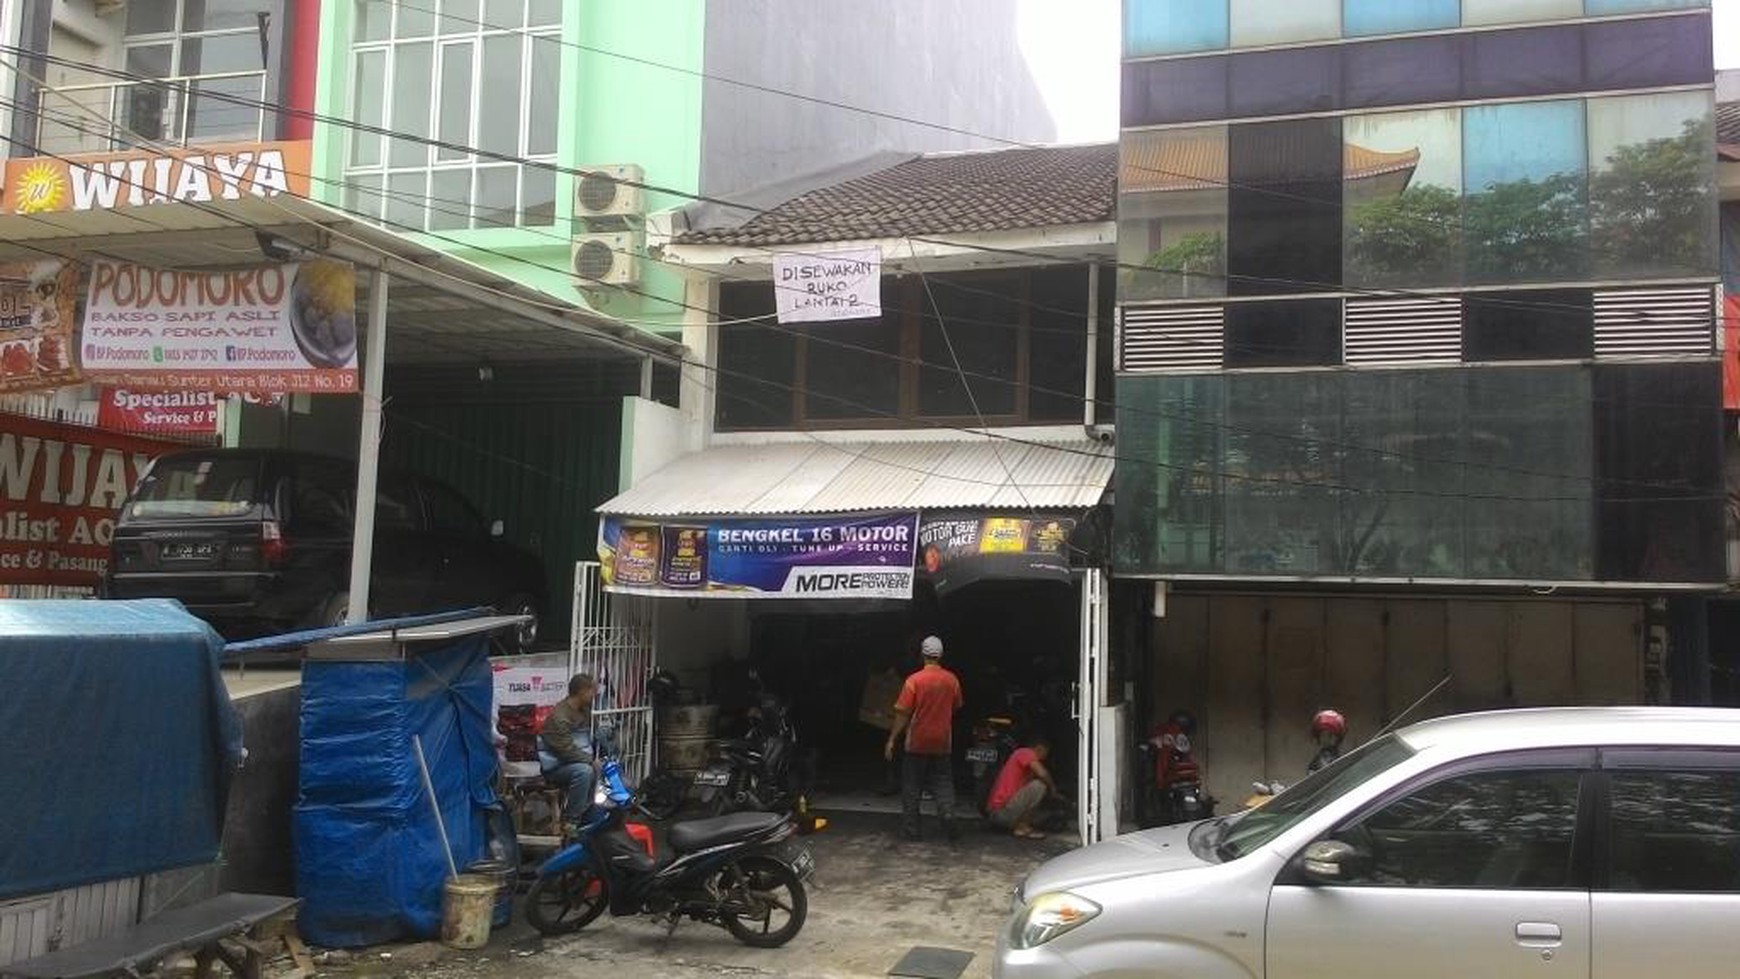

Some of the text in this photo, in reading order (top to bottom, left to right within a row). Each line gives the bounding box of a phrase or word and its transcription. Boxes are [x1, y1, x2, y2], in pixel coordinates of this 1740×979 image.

[70, 151, 289, 210] WIJAYA
[782, 261, 871, 281] DISEWAKAN
[92, 263, 284, 308] PODOMORO
[807, 281, 847, 295] RUKO
[795, 294, 858, 308] LANTAI 2
[91, 311, 280, 322] BAKSO SAPI ASLI
[91, 327, 279, 337] TANPA PENGAWET
[167, 374, 211, 387] Sunter
[217, 375, 253, 387] Utara
[260, 375, 287, 388] Blok
[315, 375, 335, 387] No.
[340, 375, 354, 387] 19
[113, 389, 217, 410] Specialist
[143, 411, 190, 424] Service
[193, 411, 204, 423] &
[0, 511, 59, 543] list
[718, 526, 808, 543] BENGKEL
[812, 527, 832, 542] 16
[840, 525, 908, 542] MOTOR
[718, 543, 908, 553] GANTI OLI TUNE UP SERVICE
[948, 533, 976, 547] PAKE
[26, 549, 42, 570] &
[48, 552, 108, 575] Pasang
[795, 573, 862, 593] MORE
